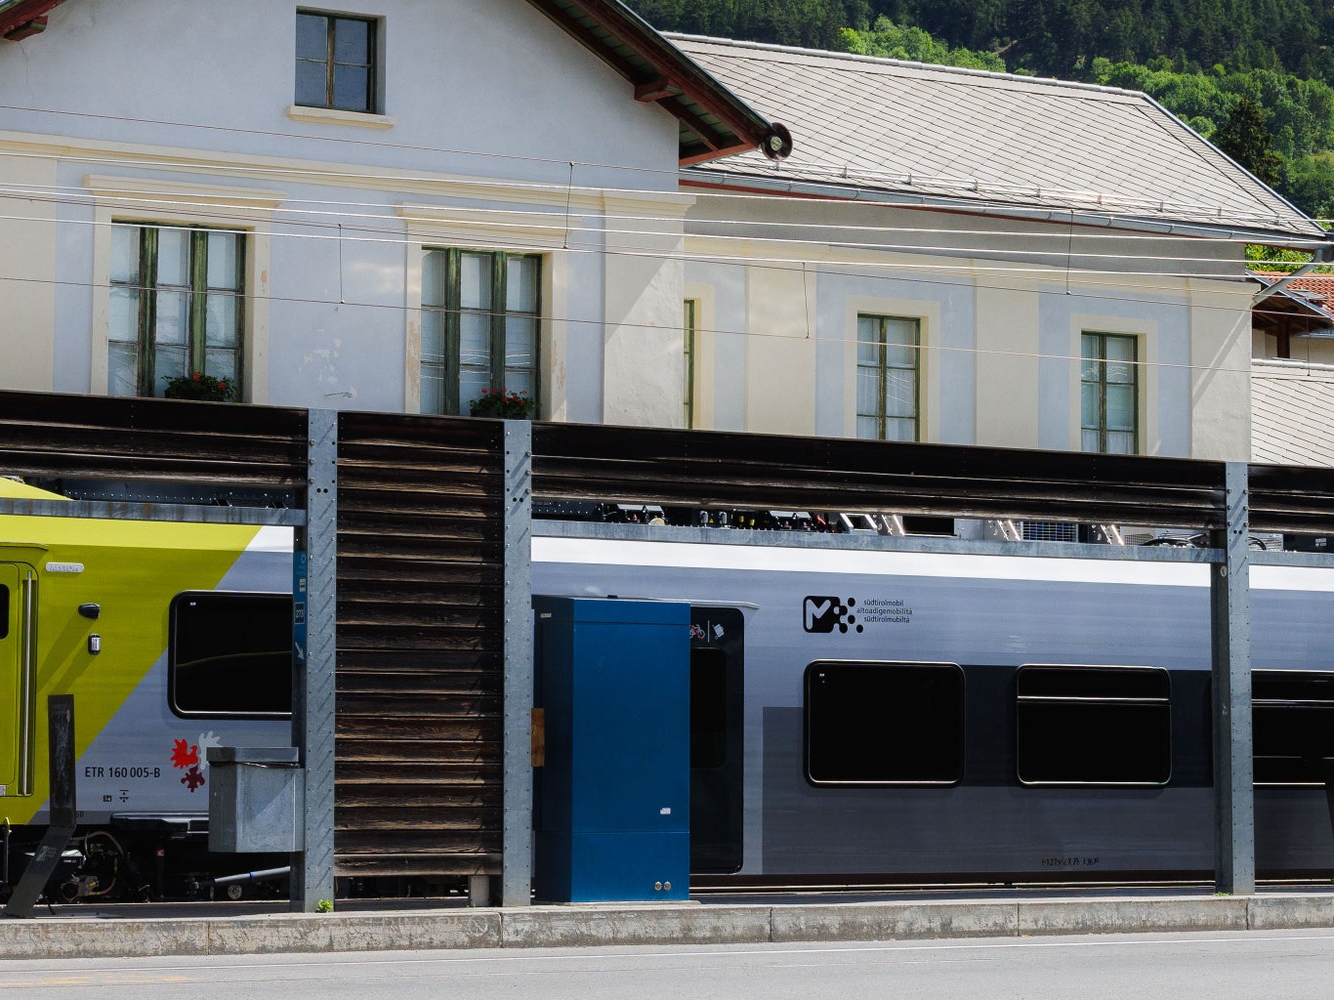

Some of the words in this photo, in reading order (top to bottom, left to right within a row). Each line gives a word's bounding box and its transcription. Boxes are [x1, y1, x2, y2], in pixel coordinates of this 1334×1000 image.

[85, 766, 104, 778] ETR
[109, 766, 127, 778] 160
[130, 767, 161, 778] 005-B
